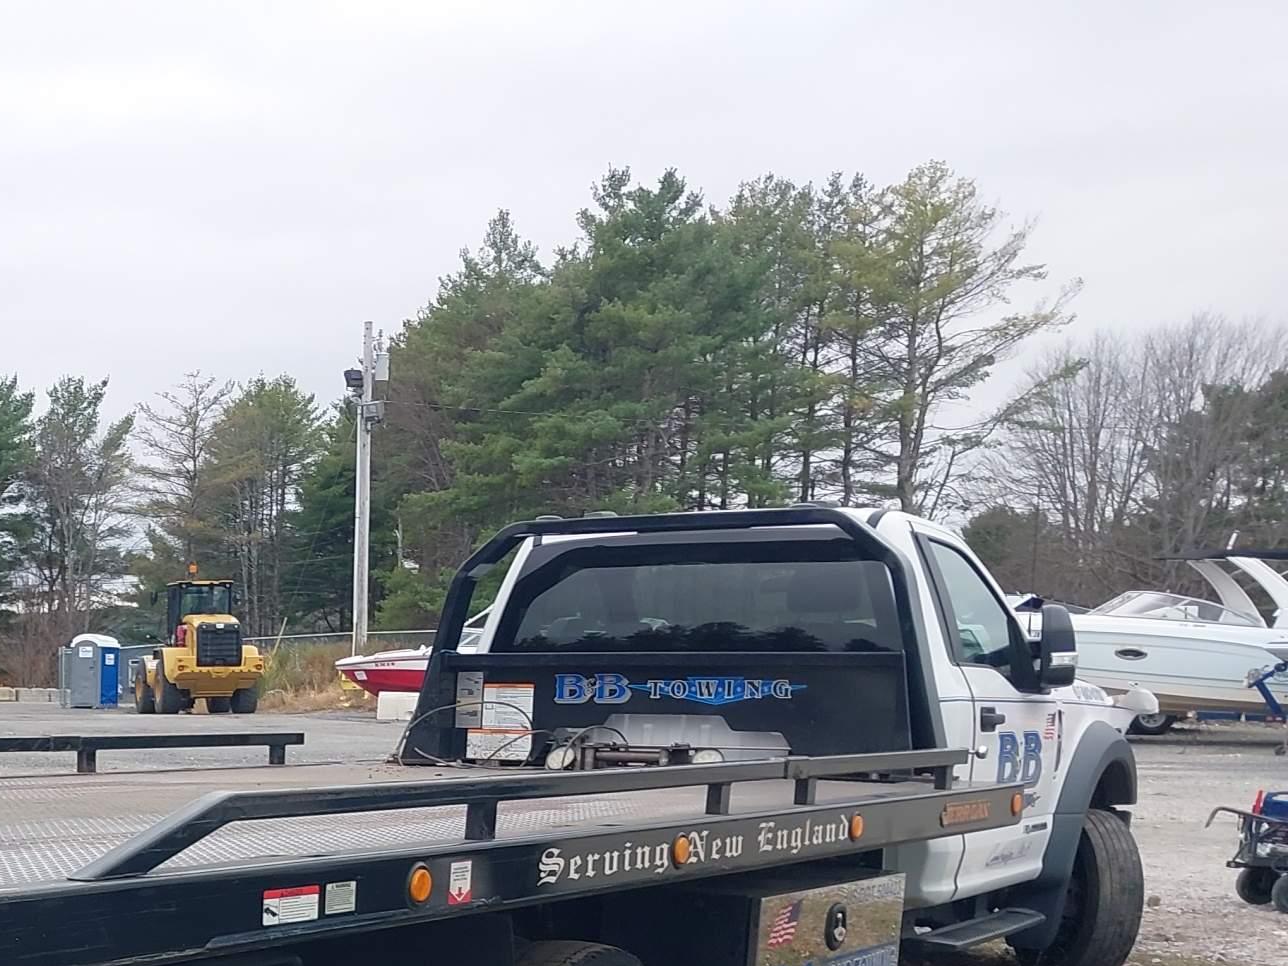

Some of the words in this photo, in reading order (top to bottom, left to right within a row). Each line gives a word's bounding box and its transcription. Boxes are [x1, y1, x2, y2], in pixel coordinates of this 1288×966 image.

[553, 673, 632, 703] B&B
[647, 679, 793, 698] TOWING
[537, 842, 670, 887] Serving
[686, 830, 744, 864] New
[757, 815, 850, 854] England
